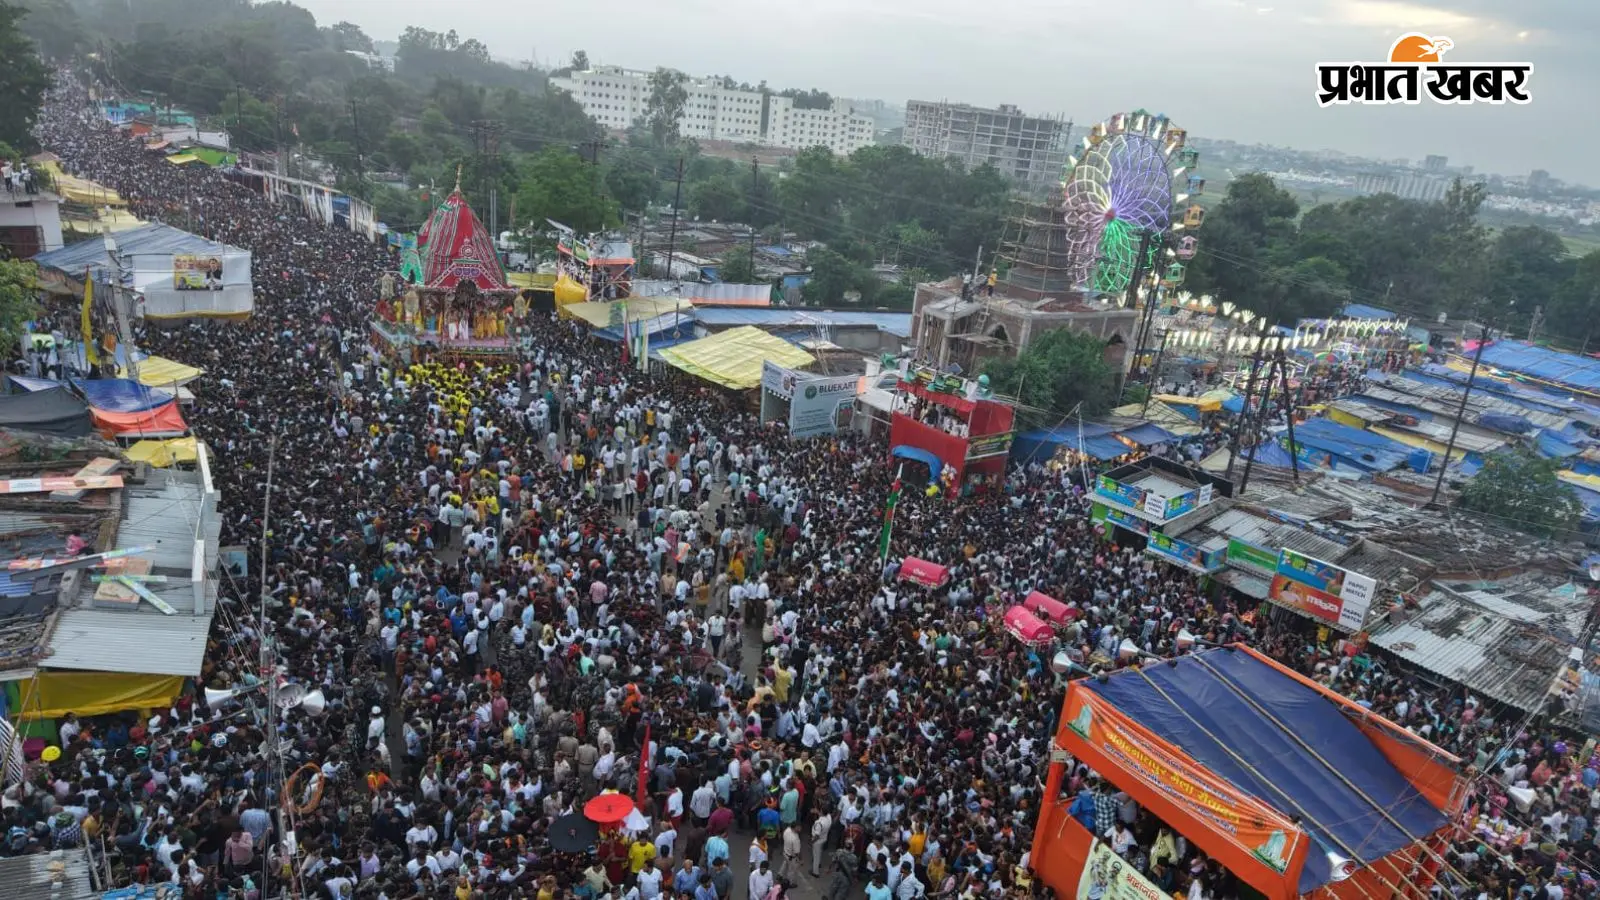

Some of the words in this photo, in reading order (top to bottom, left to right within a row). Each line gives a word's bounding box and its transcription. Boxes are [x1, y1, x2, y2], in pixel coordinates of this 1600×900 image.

[819, 382, 857, 393] BLUEKART
[1348, 581, 1367, 592] PAPPU
[1170, 770, 1195, 795] मेला
